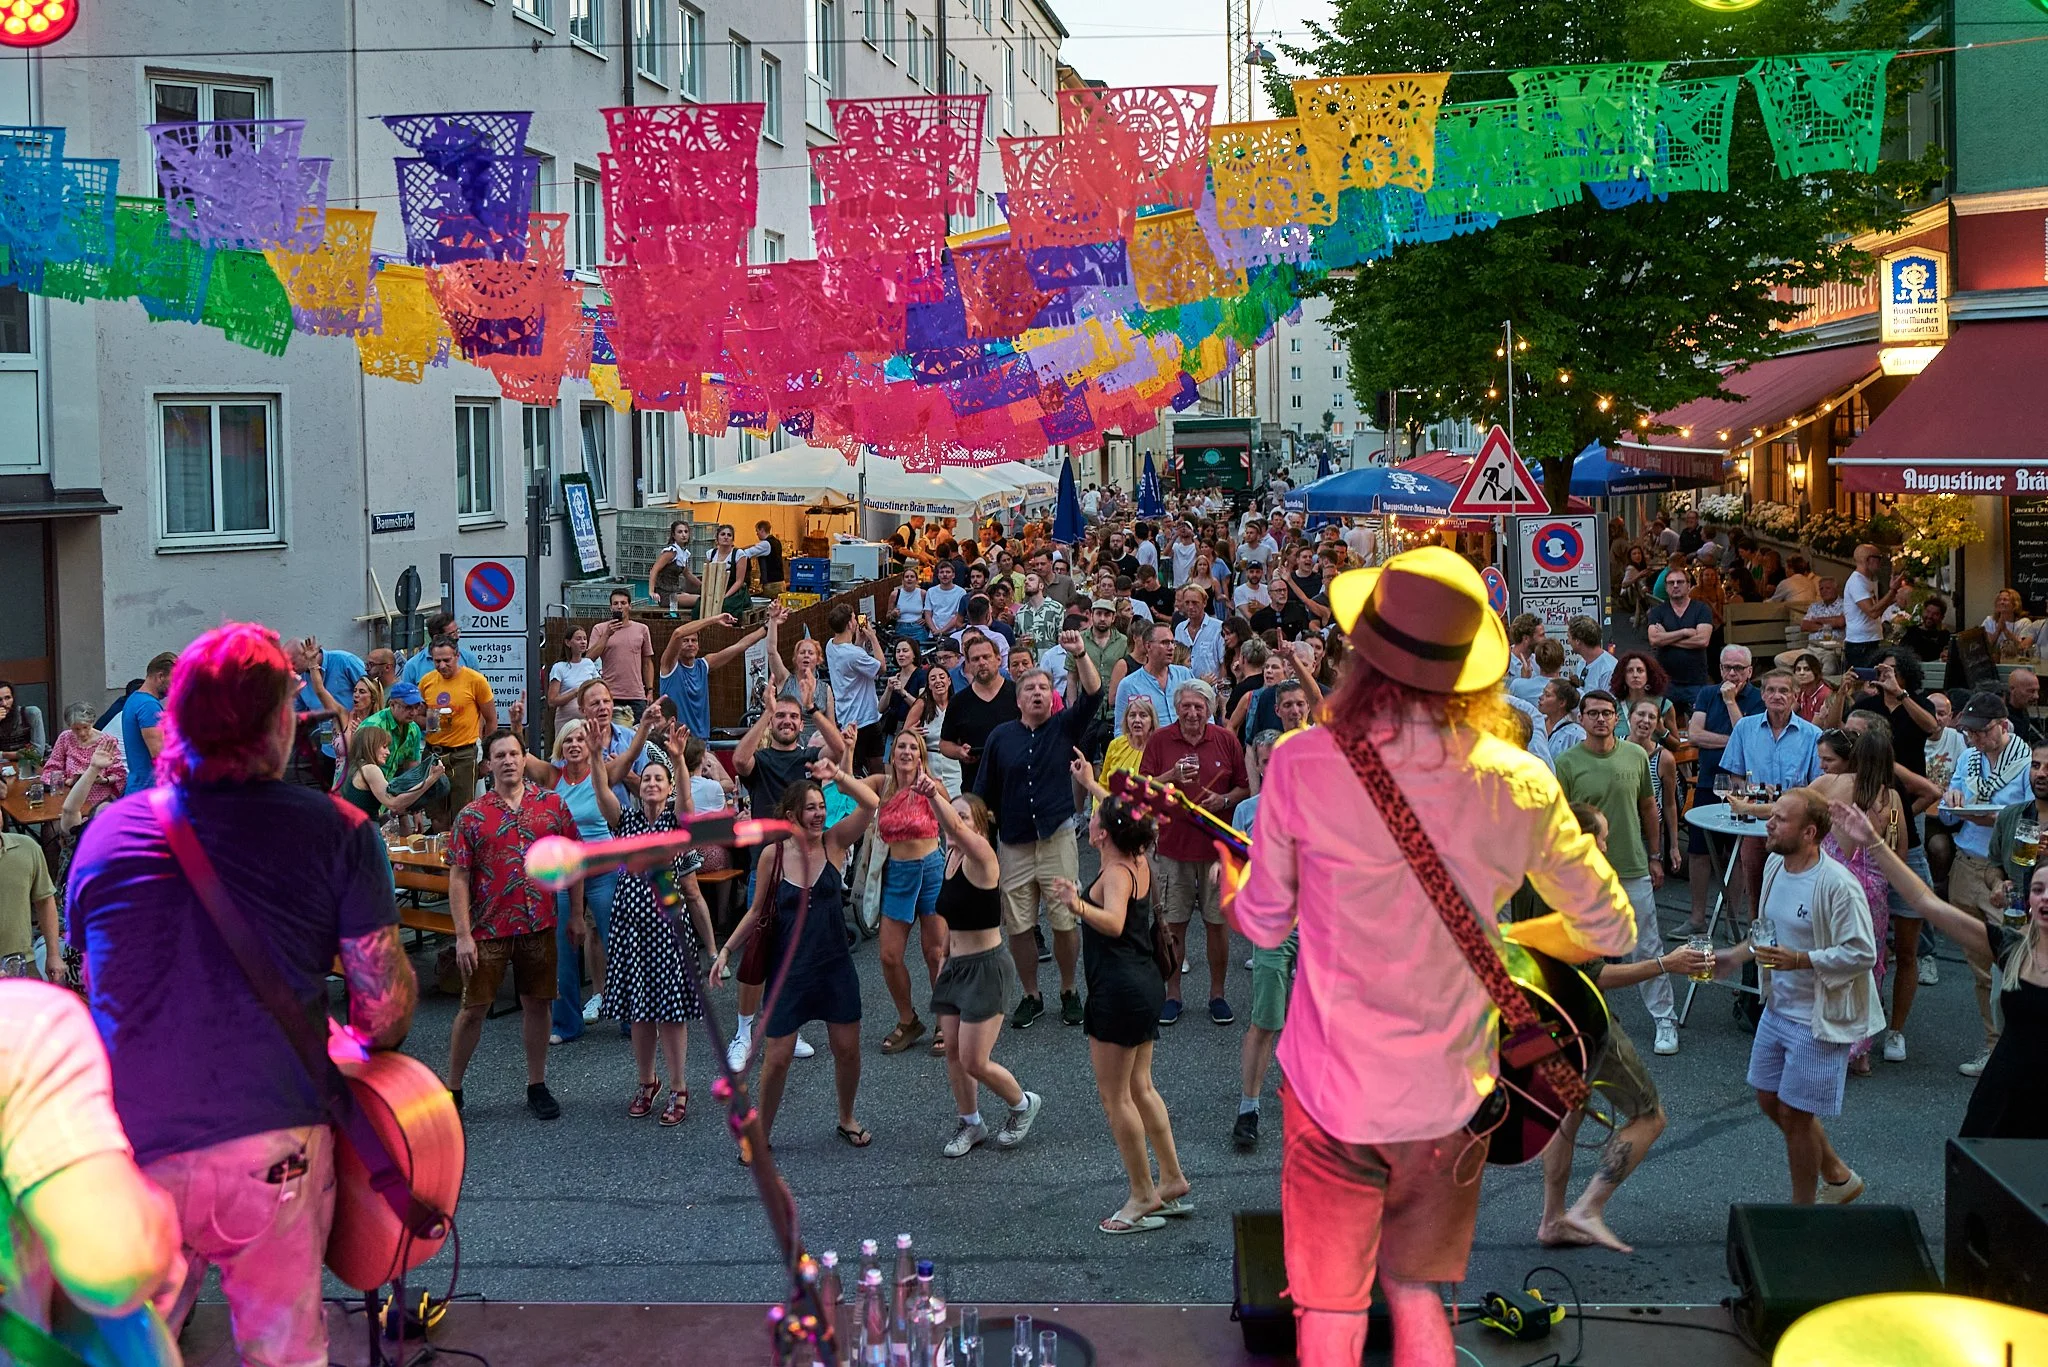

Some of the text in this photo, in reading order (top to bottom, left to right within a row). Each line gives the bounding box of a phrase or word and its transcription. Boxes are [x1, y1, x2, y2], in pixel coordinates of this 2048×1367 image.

[1902, 468, 2006, 493] Augustiner
[376, 514, 413, 530] Baumstraße
[1538, 605, 1583, 615] werktags
[471, 615, 509, 628] ZONE
[469, 643, 512, 653] werktags
[499, 654, 504, 663] h
[508, 674, 523, 682] mit
[492, 687, 520, 695] sweis
